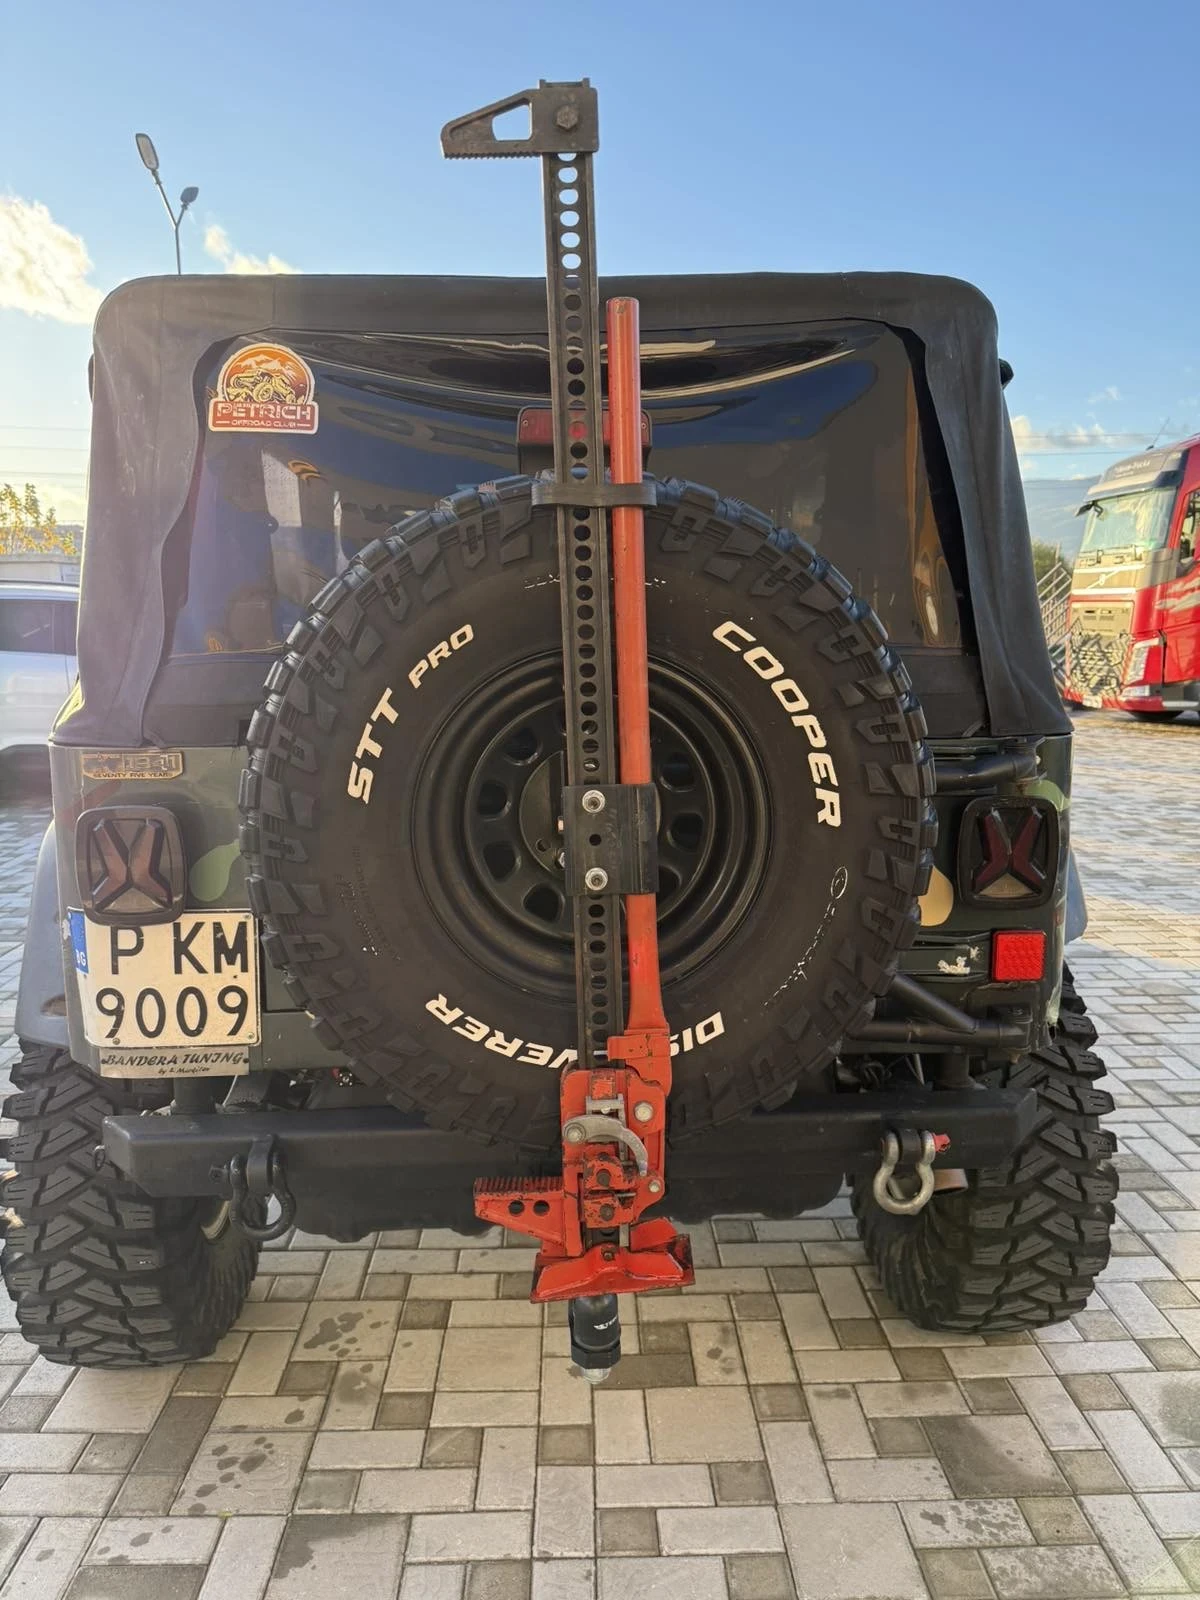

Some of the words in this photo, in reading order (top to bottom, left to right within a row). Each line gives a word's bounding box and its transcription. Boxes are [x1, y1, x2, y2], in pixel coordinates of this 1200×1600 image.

[216, 402, 311, 420] PETRICH
[347, 687, 399, 804] STT
[408, 624, 474, 689] PRO
[712, 621, 841, 827] COOPER
[109, 925, 145, 975] P
[172, 921, 249, 974] KM
[95, 985, 249, 1039] 9009
[105, 1053, 179, 1066] BANDERA
[182, 1051, 244, 1065] TUNING
